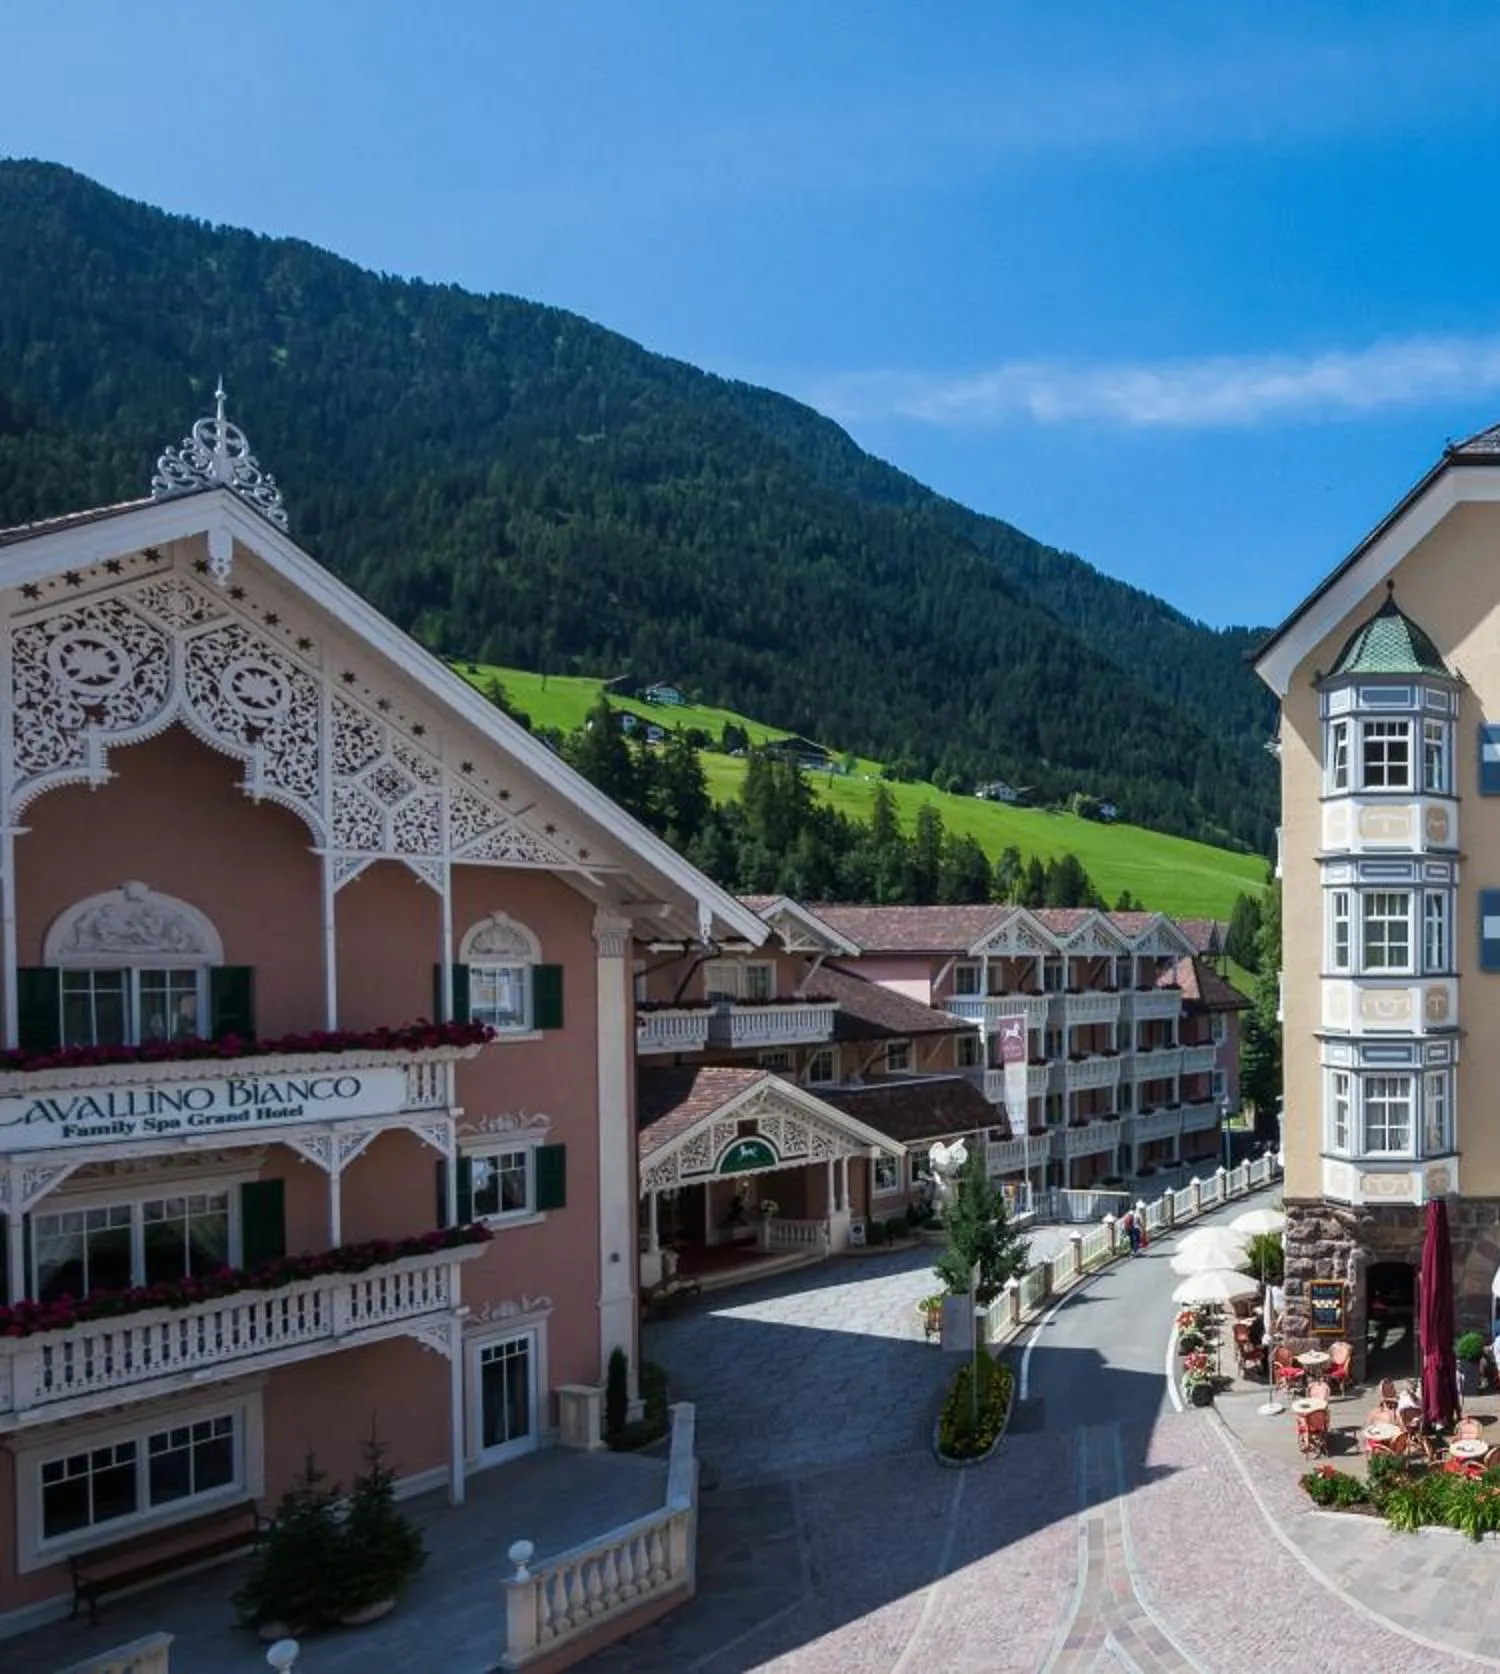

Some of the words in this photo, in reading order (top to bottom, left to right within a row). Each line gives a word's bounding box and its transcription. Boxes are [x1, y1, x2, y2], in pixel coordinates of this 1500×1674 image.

[227, 1076, 361, 1107] BIANCO
[62, 1121, 136, 1139] Family
[143, 1116, 181, 1133] Spa
[188, 1110, 250, 1126] Grand
[256, 1105, 304, 1121] Hotel
